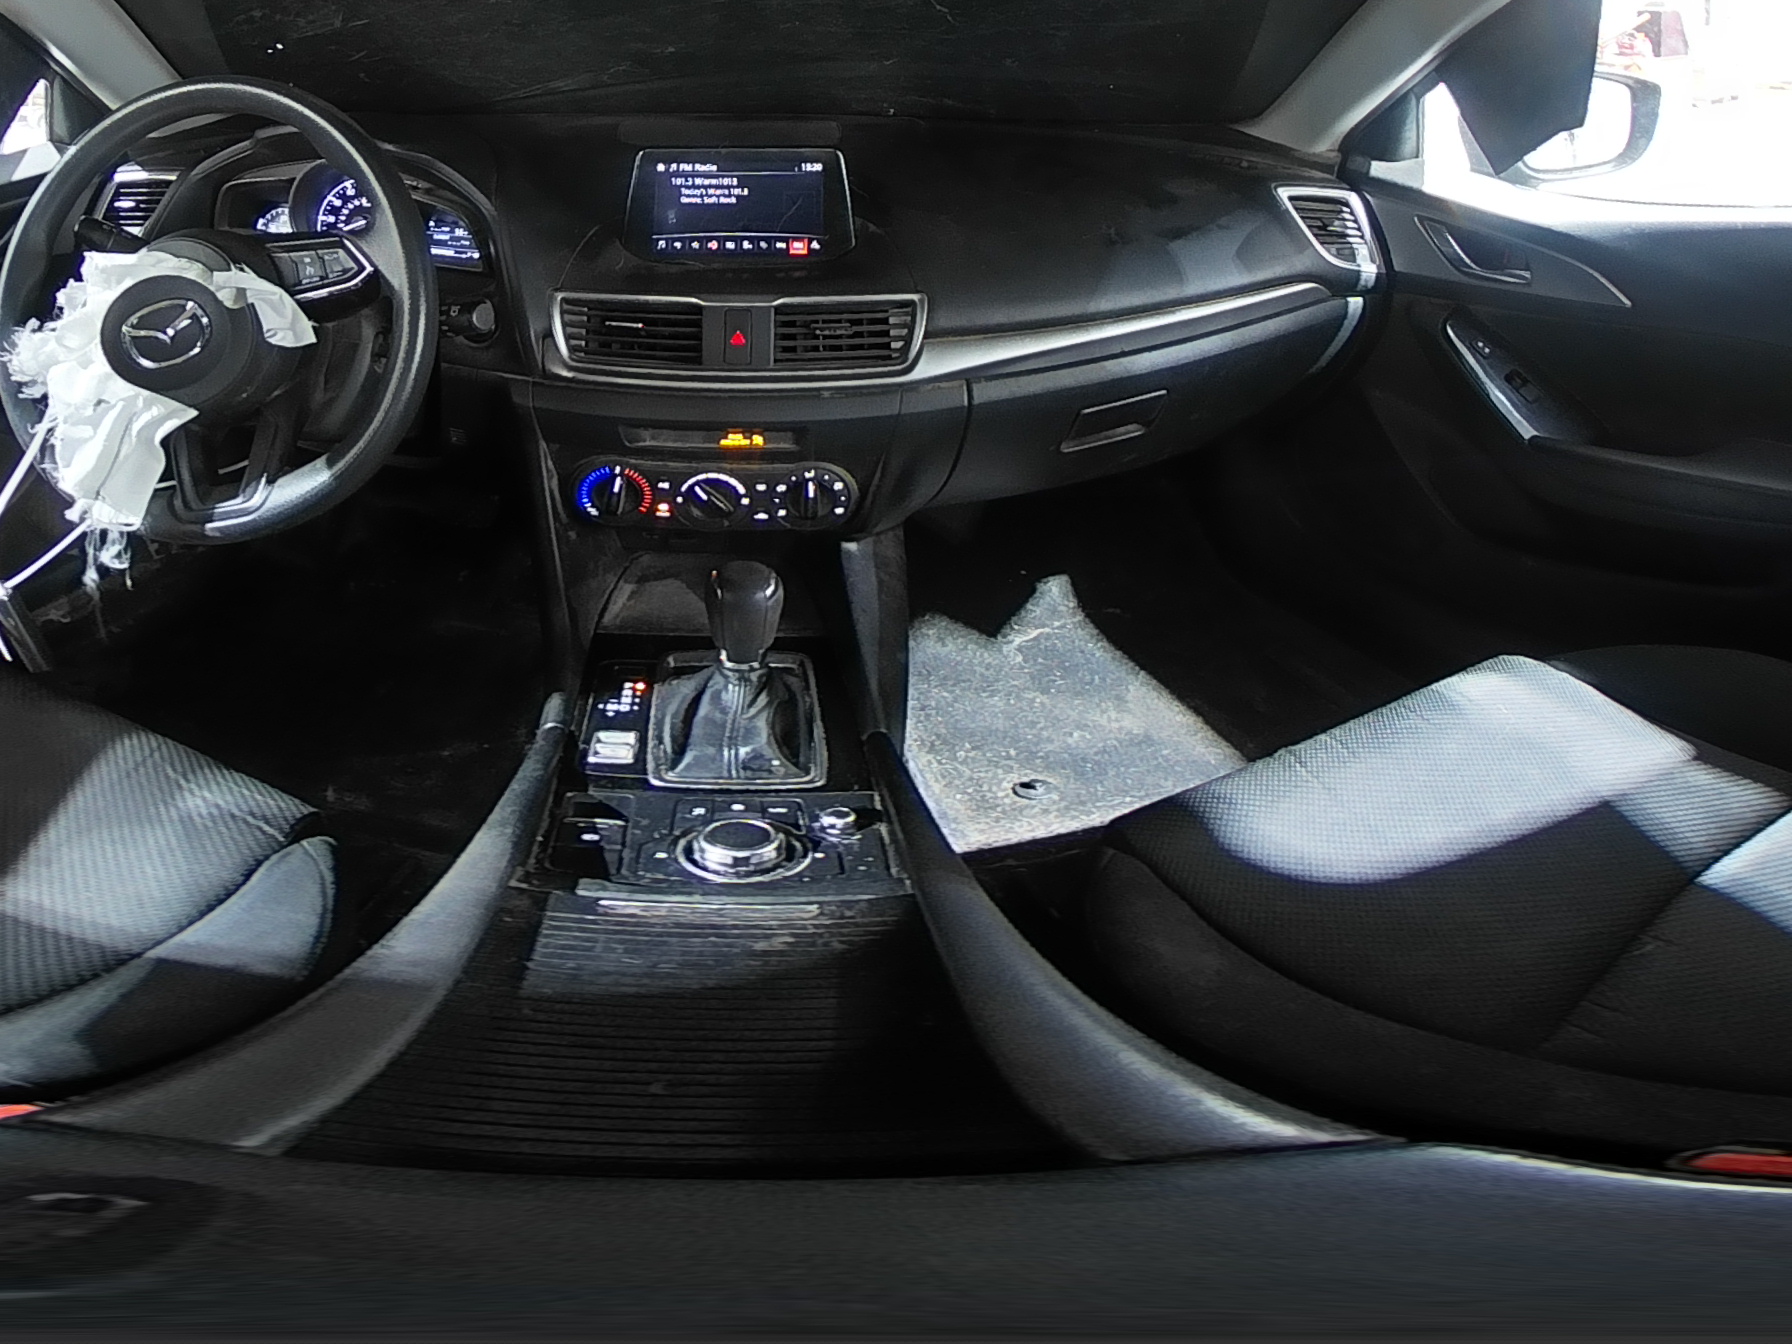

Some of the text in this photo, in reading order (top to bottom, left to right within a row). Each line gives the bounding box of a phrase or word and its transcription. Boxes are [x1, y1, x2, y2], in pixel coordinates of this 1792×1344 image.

[679, 163, 717, 172] FM Radio
[671, 177, 692, 186] 101.3
